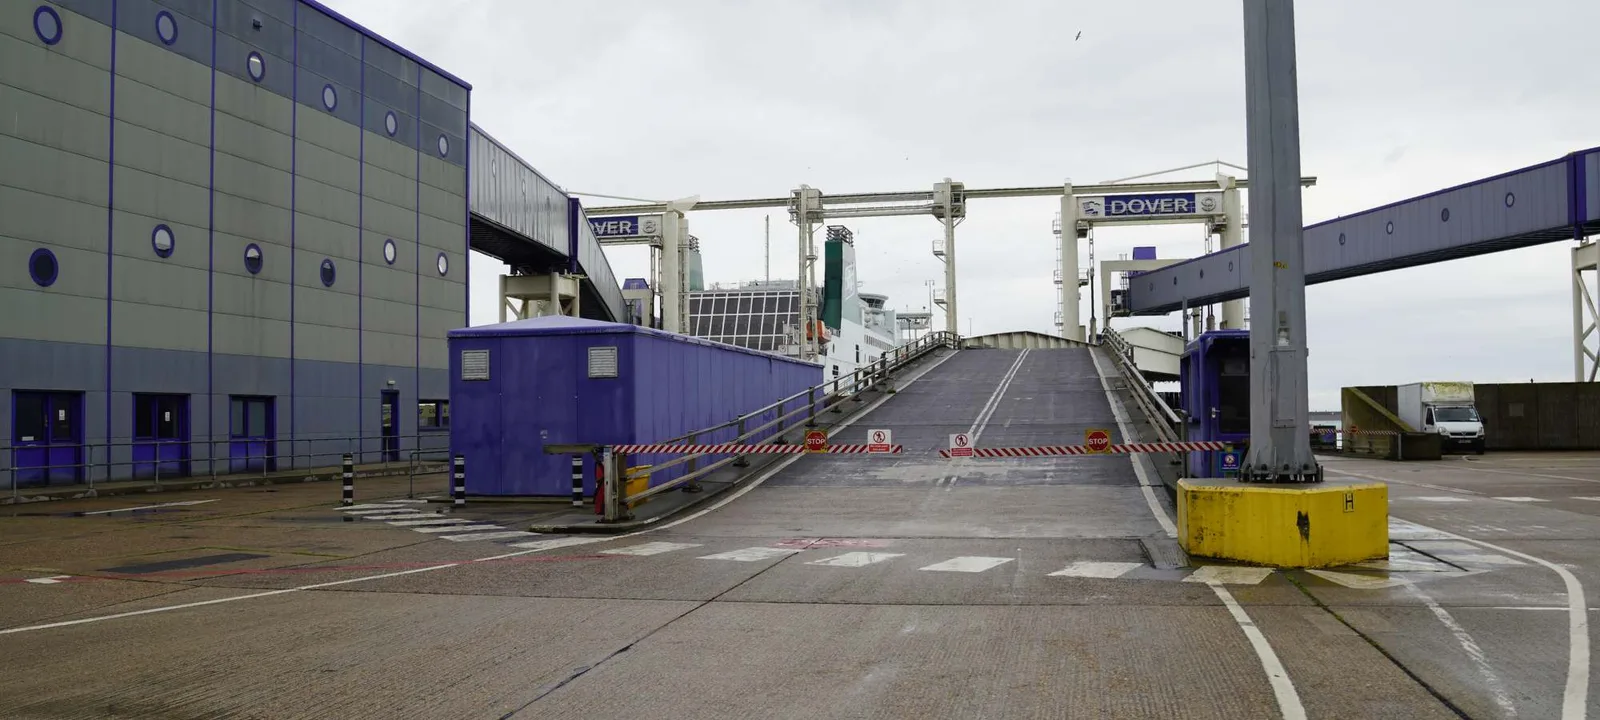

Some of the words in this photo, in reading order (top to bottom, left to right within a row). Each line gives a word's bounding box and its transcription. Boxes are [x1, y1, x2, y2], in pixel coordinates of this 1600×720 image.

[1111, 198, 1188, 214] DOVER
[1201, 196, 1216, 212] 9
[589, 220, 632, 235] VER
[1088, 437, 1108, 445] STOP
[1345, 492, 1354, 511] H
